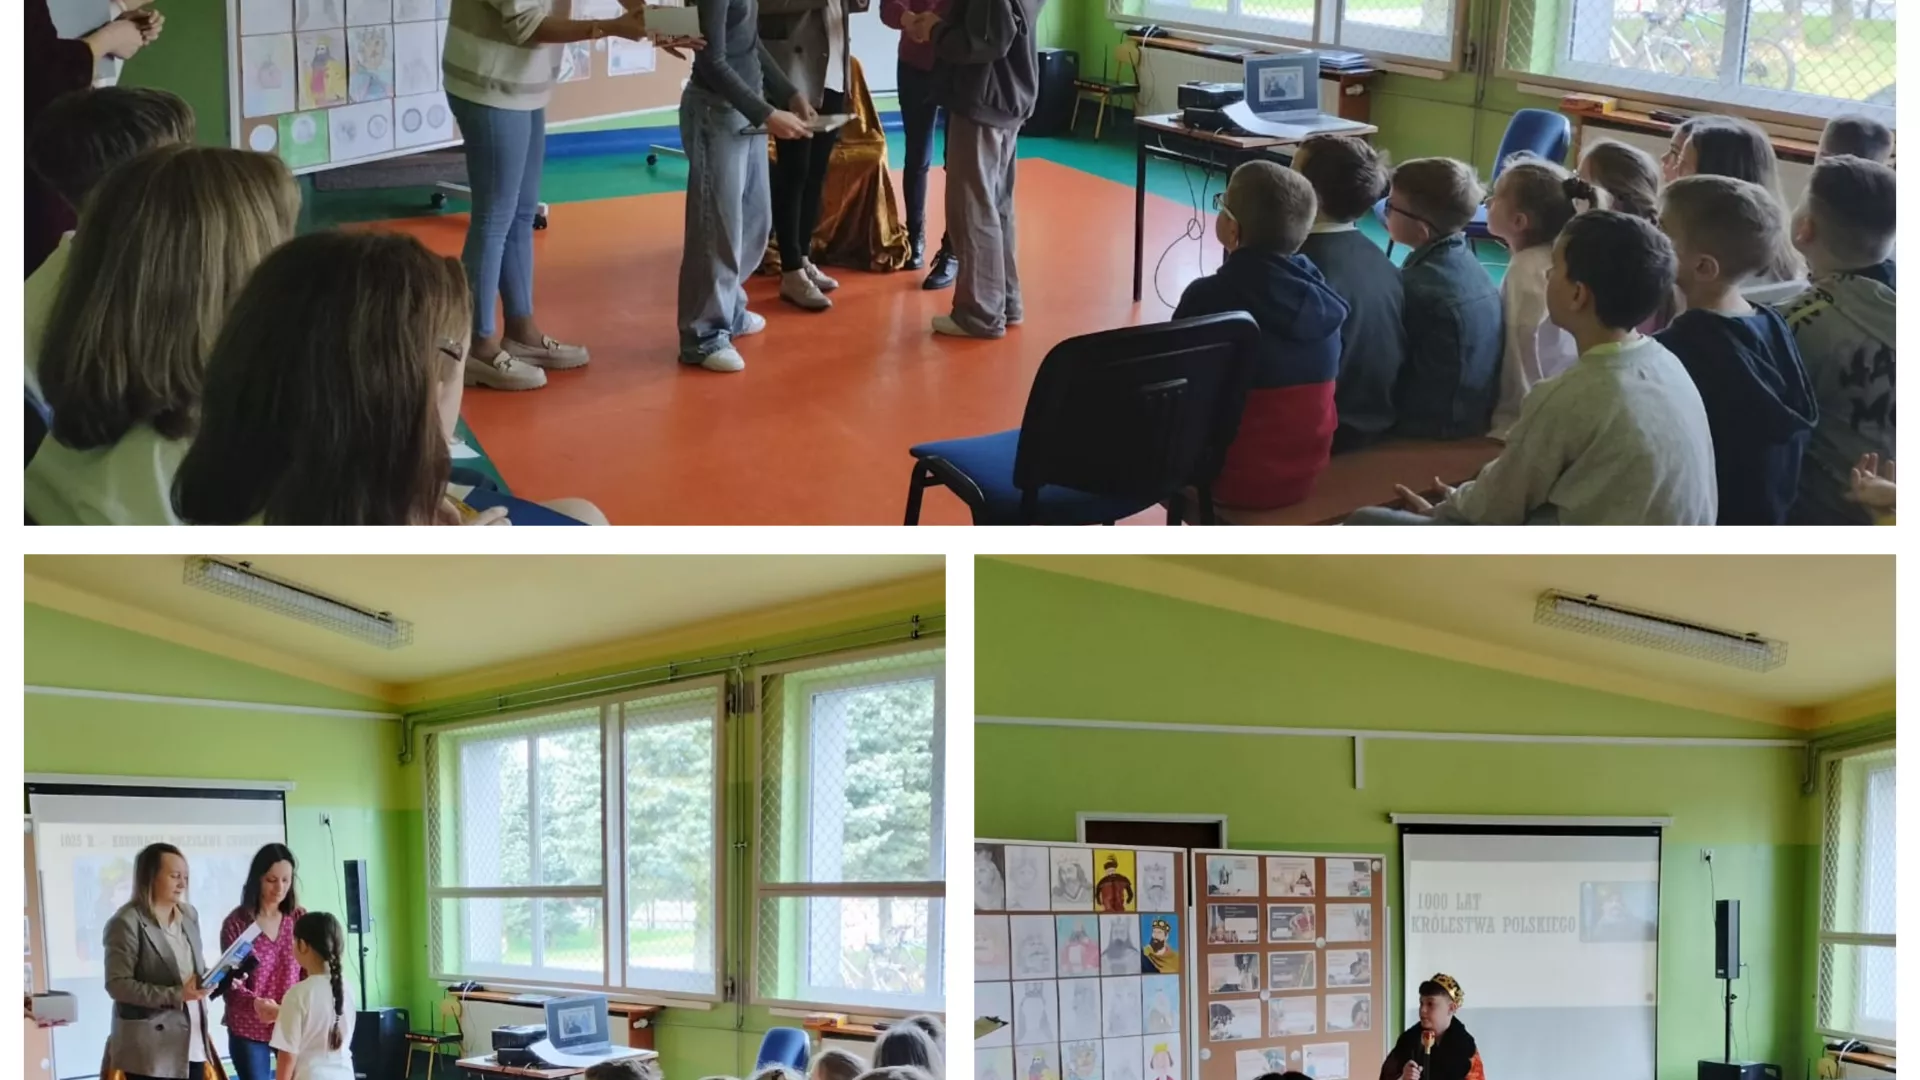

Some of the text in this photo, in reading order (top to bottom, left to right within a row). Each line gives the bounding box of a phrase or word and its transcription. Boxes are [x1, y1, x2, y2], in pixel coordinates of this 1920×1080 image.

[1417, 892, 1482, 910] 1000 LAT
[1411, 912, 1577, 934] KRÓLESTWA POLSKIEGO
